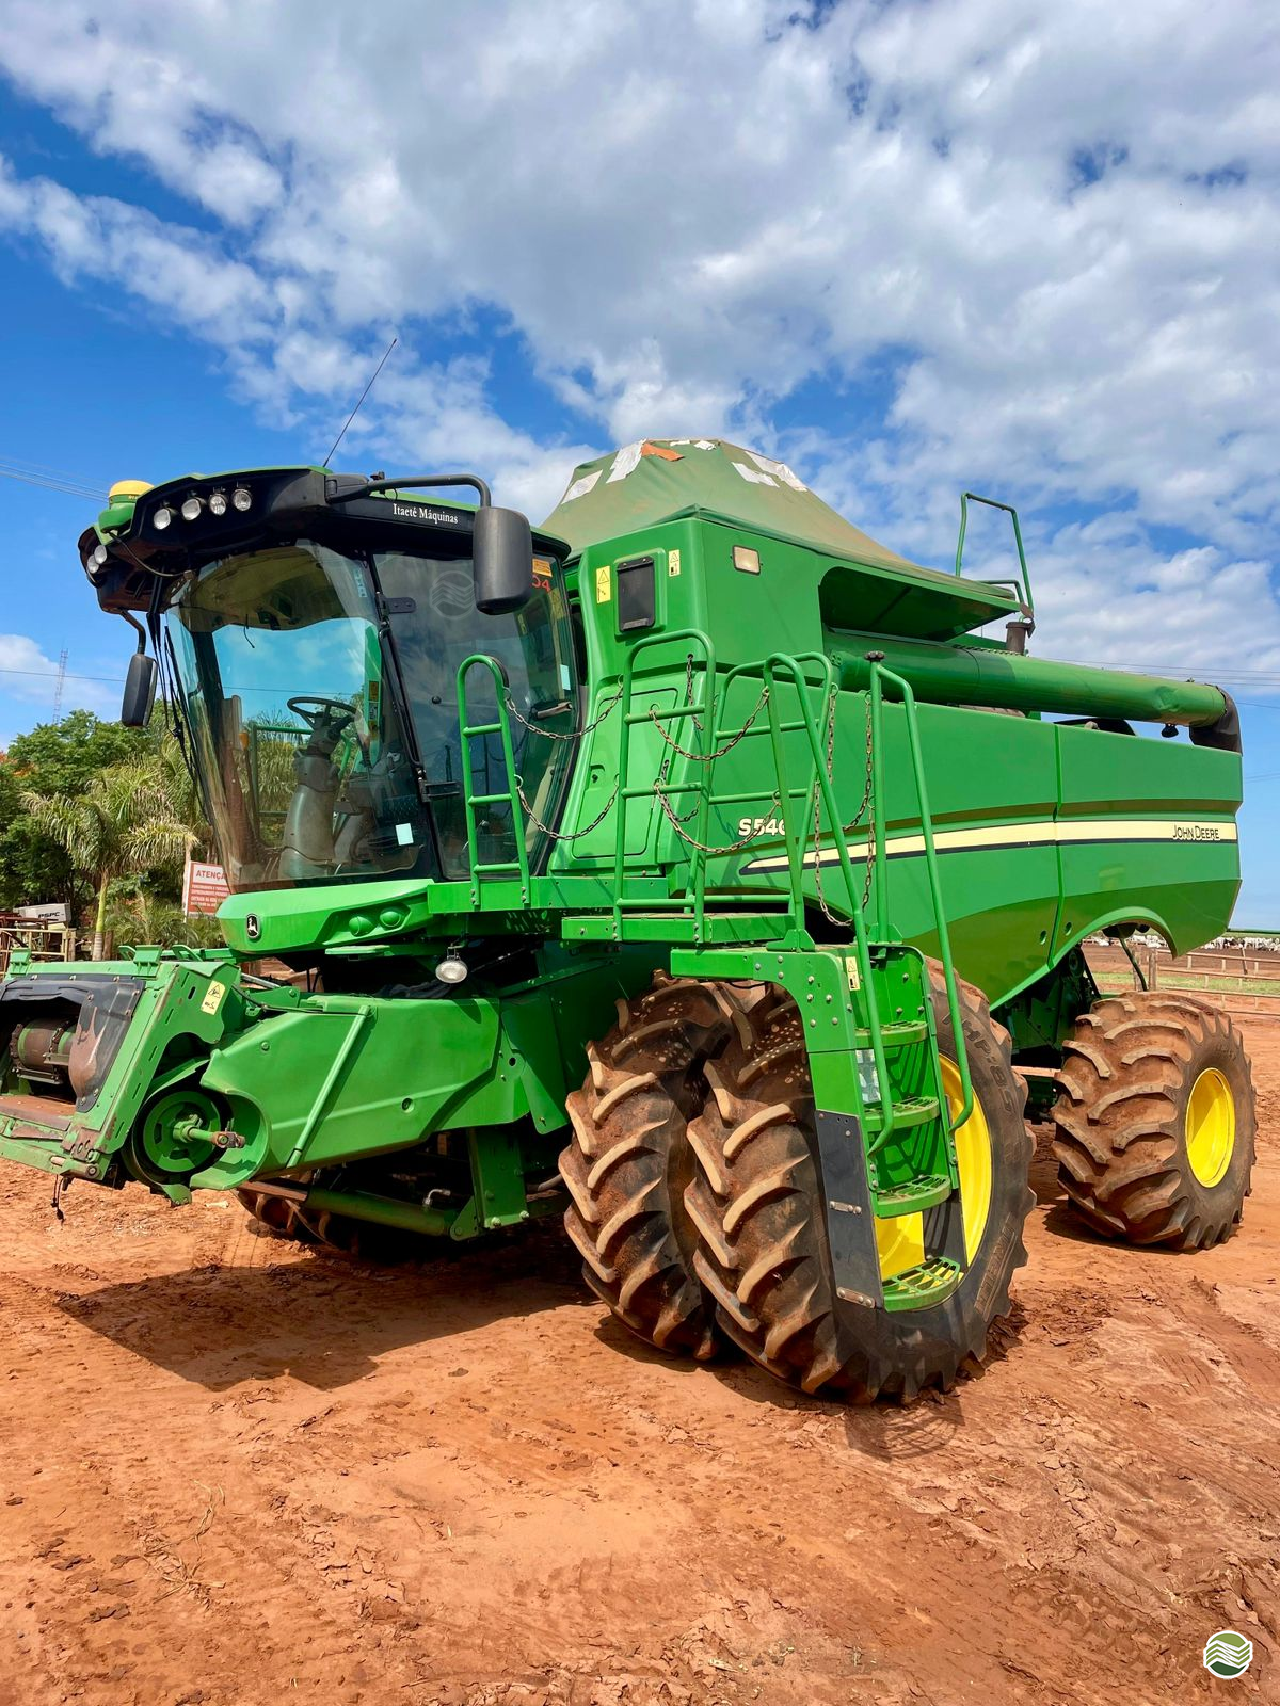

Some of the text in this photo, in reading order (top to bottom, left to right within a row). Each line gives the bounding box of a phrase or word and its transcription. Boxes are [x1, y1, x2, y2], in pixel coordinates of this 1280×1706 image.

[419, 507, 459, 525] Máquinas
[1172, 824, 1220, 839] JOHN DEERE
[195, 869, 227, 881] ATENÇ
[942, 1013, 1015, 1113] HP:85
